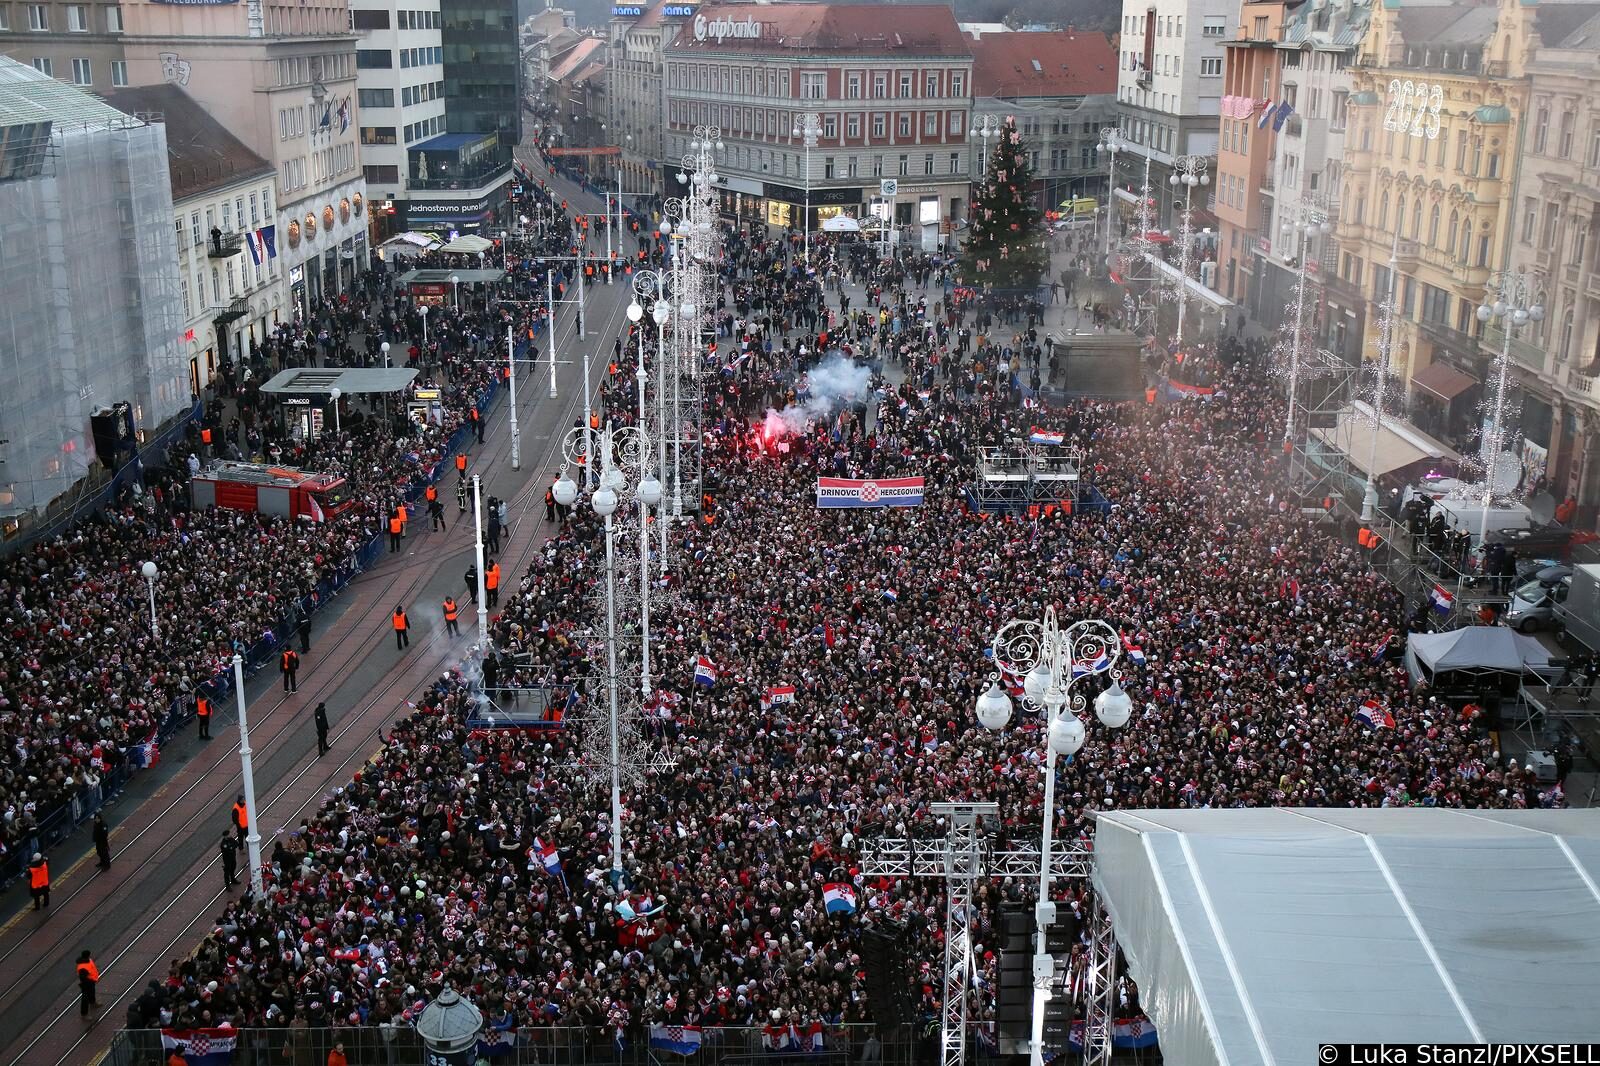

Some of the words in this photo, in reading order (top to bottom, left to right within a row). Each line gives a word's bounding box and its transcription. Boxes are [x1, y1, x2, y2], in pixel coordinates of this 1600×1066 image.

[1383, 79, 1444, 139] 2023
[461, 203, 479, 213] puno
[821, 489, 859, 497] DRINOVCI
[880, 487, 924, 496] HERCEGOVINA
